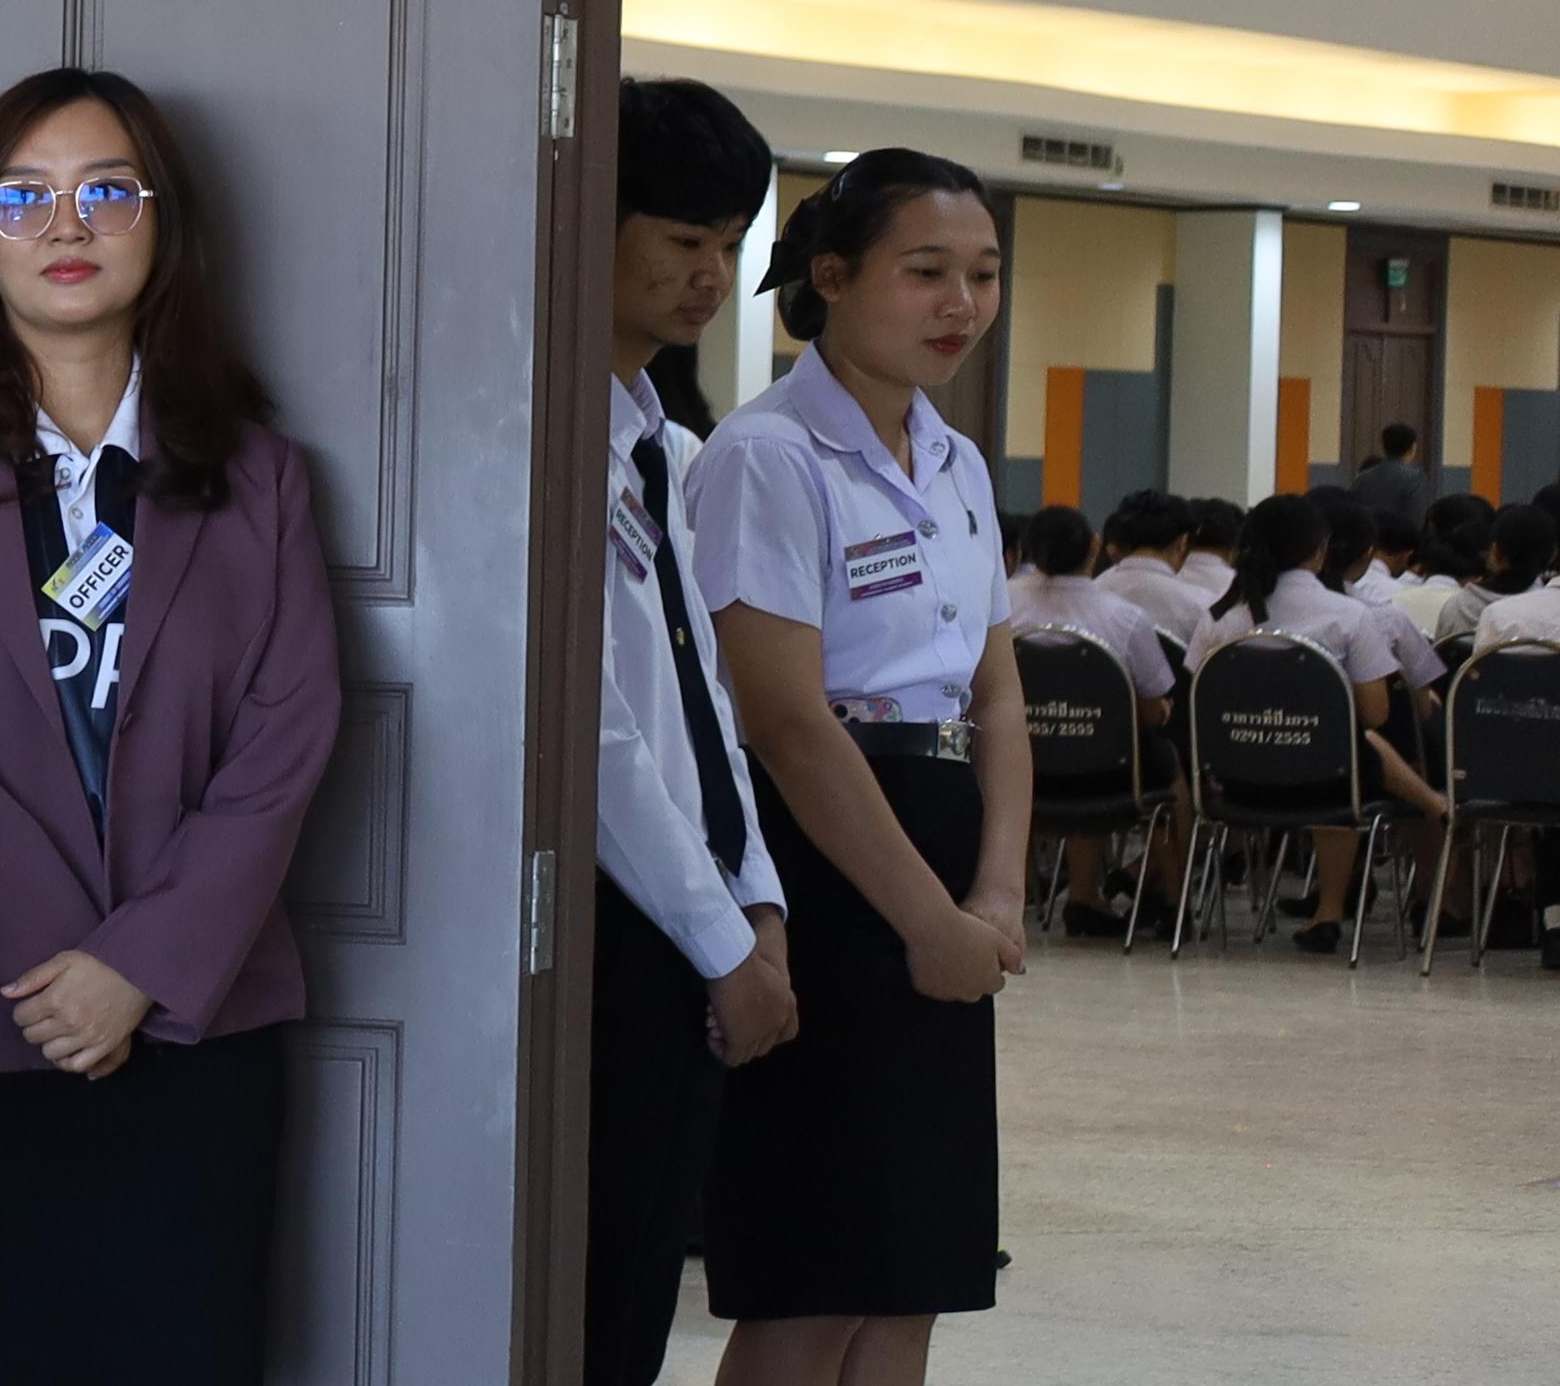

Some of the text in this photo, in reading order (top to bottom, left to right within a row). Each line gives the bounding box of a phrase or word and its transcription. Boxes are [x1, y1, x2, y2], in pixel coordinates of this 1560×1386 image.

[615, 508, 654, 562] RECEPTION
[69, 544, 129, 609] OFFICER
[850, 553, 916, 579] RECEPTION
